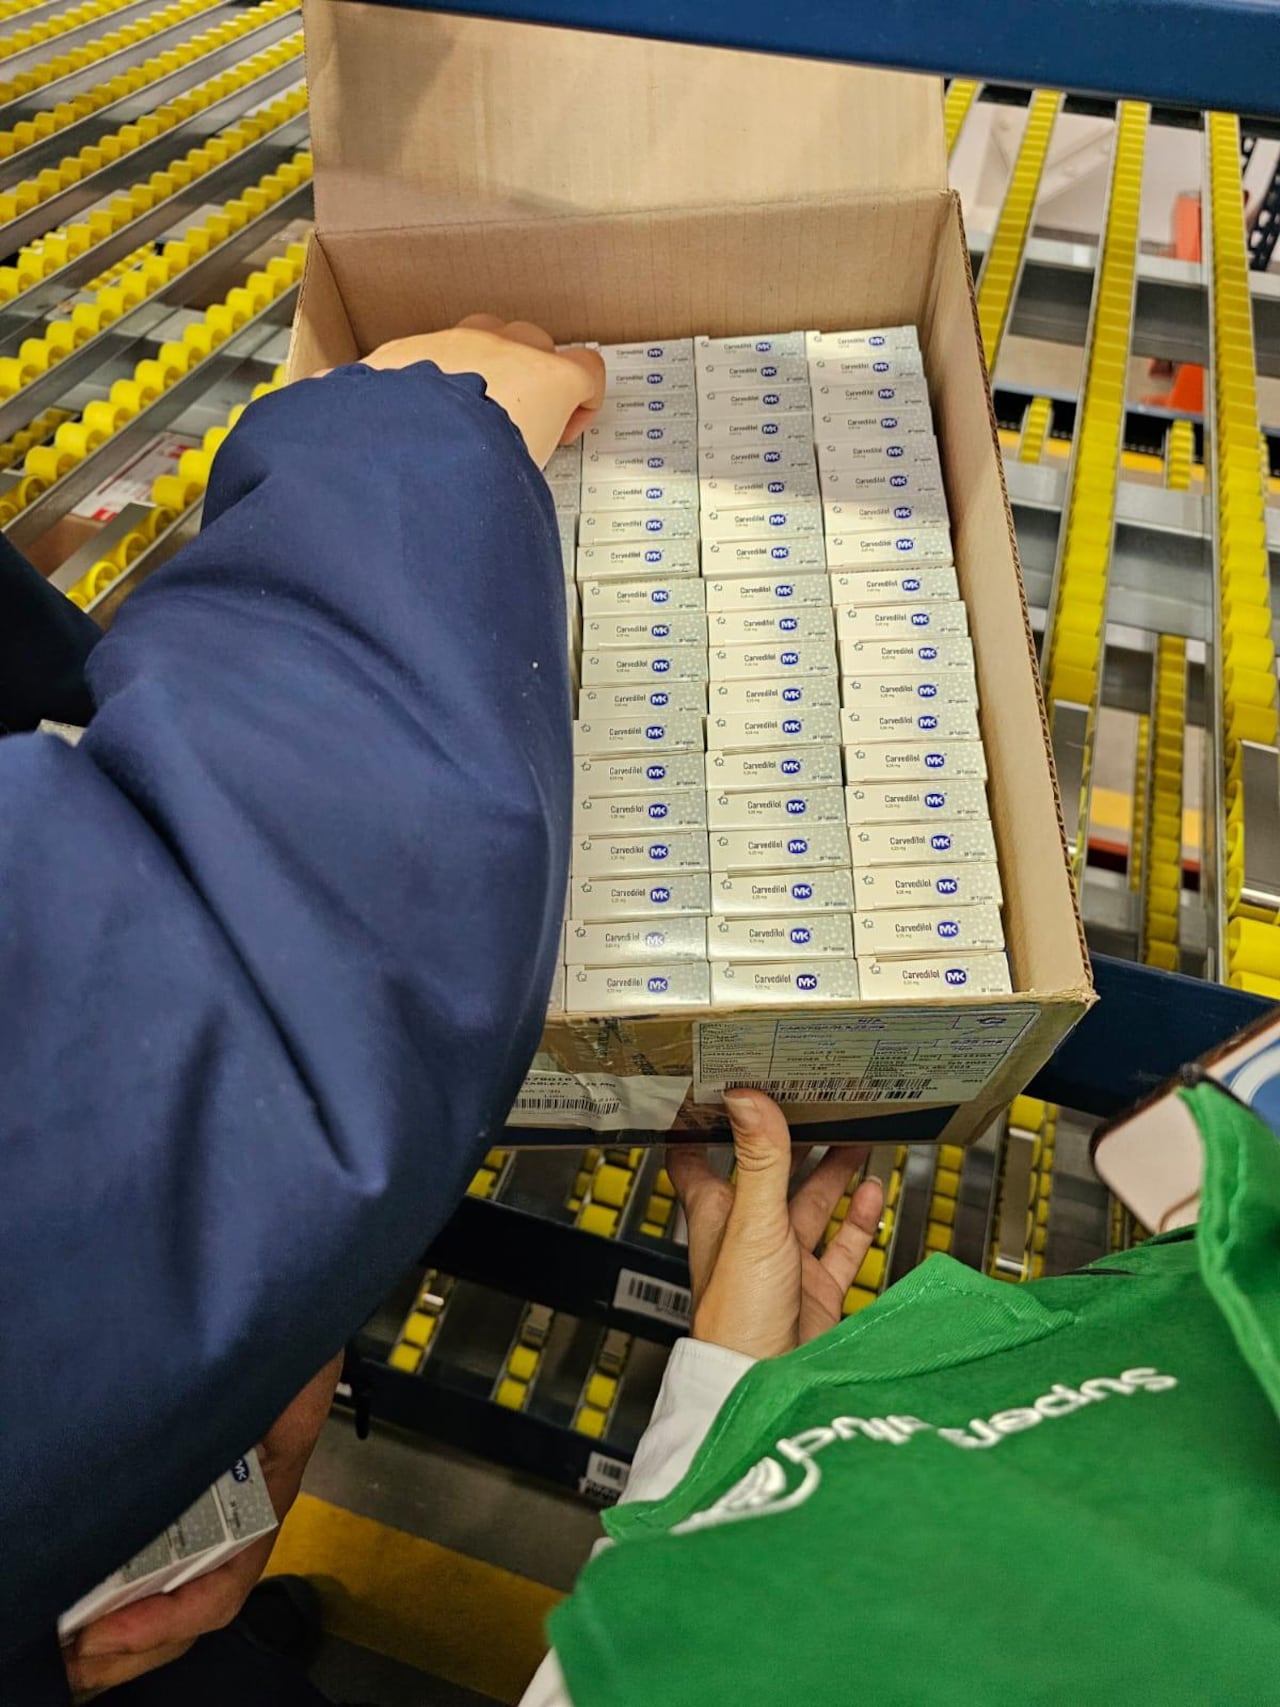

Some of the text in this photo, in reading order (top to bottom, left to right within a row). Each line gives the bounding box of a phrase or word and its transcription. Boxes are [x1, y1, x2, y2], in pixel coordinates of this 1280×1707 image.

[870, 337, 883, 345] MK
[762, 368, 775, 376] MK
[874, 363, 888, 371] MK
[648, 375, 662, 383] MK
[764, 395, 778, 403] MK
[879, 390, 893, 398] MK
[649, 402, 663, 410] MK
[882, 419, 896, 427] MK
[648, 430, 662, 438] MK
[763, 425, 777, 433] MK
[888, 447, 902, 456] MK
[765, 453, 779, 461] MK
[648, 458, 663, 467] MK
[891, 477, 906, 486] MK
[769, 483, 783, 492] MK
[647, 489, 661, 498] MK
[859, 508, 910, 517] Carvedilol MK
[735, 515, 784, 524] Carvedilol MK
[612, 520, 661, 530] Carvedilol MK
[861, 540, 912, 549] Carvedilol MK
[611, 551, 661, 561] Carvedilol MK
[737, 548, 787, 557] Carvedilol MK
[867, 580, 919, 589] Carvedilol MK
[740, 586, 792, 595] Carvedilol MK
[617, 591, 667, 601] Carvedilol MK
[744, 619, 796, 629] Carvedilol MK
[875, 614, 928, 624] Carvedilol MK
[616, 625, 668, 635] Carvedilol MK
[744, 653, 797, 663] Carvedilol MK
[882, 648, 935, 658] Carvedilol MK
[616, 660, 668, 671] Carvedilol MK
[746, 688, 800, 700] Carvedilol MK
[880, 685, 935, 696] Carvedilol MK
[614, 694, 667, 704] Carvedilol MK
[745, 721, 800, 732] Carvedilol MK
[880, 717, 936, 728] Carvedilol MK
[609, 727, 663, 738] Carvedilol MK
[885, 754, 943, 766] Carvedilol MK
[743, 760, 799, 772] Carvedilol MK
[609, 766, 664, 778] Carvedilol MK
[885, 795, 943, 806] Carvedilol MK
[611, 805, 666, 816] Carvedilol MK
[747, 801, 804, 812] Carvedilol MK
[748, 840, 806, 852] Carvedilol MK
[890, 836, 949, 848] Carvedilol MK
[610, 846, 667, 858] Carvedilol MK
[752, 885, 811, 897] Carvedilol MK
[895, 880, 955, 892] Carvedilol MK
[611, 888, 669, 901] Carvedilol MK
[895, 922, 957, 935] Carvedilol MK
[646, 934, 664, 946] MK
[749, 929, 809, 942] Carvedilol MK
[755, 975, 816, 988] Carvedilol MK
[903, 970, 965, 983] Carvedilol MK
[607, 978, 667, 991] Carvedilol MK
